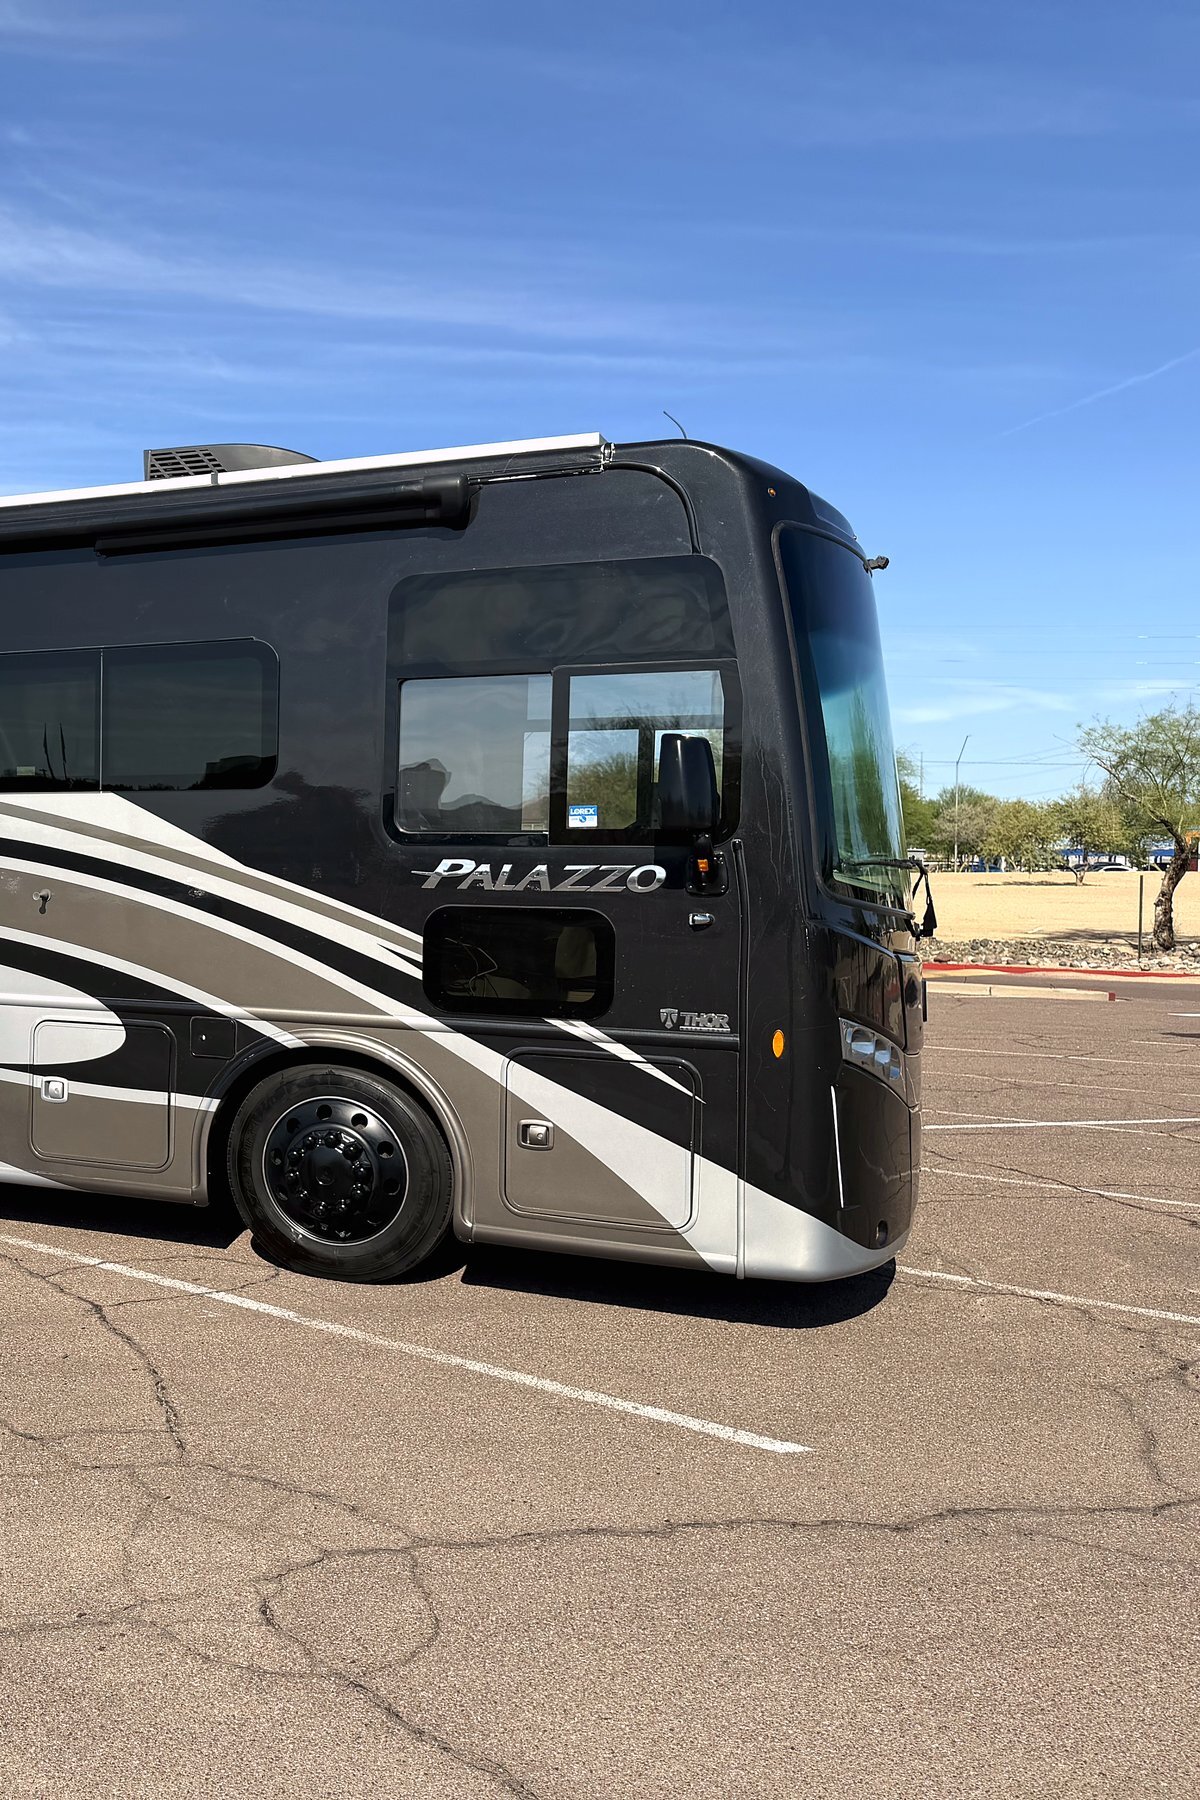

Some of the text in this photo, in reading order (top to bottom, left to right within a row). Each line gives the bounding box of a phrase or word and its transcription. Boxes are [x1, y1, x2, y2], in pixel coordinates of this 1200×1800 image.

[570, 807, 595, 815] LOREX
[411, 858, 667, 893] PALAZZO
[679, 1011, 730, 1029] THOR
